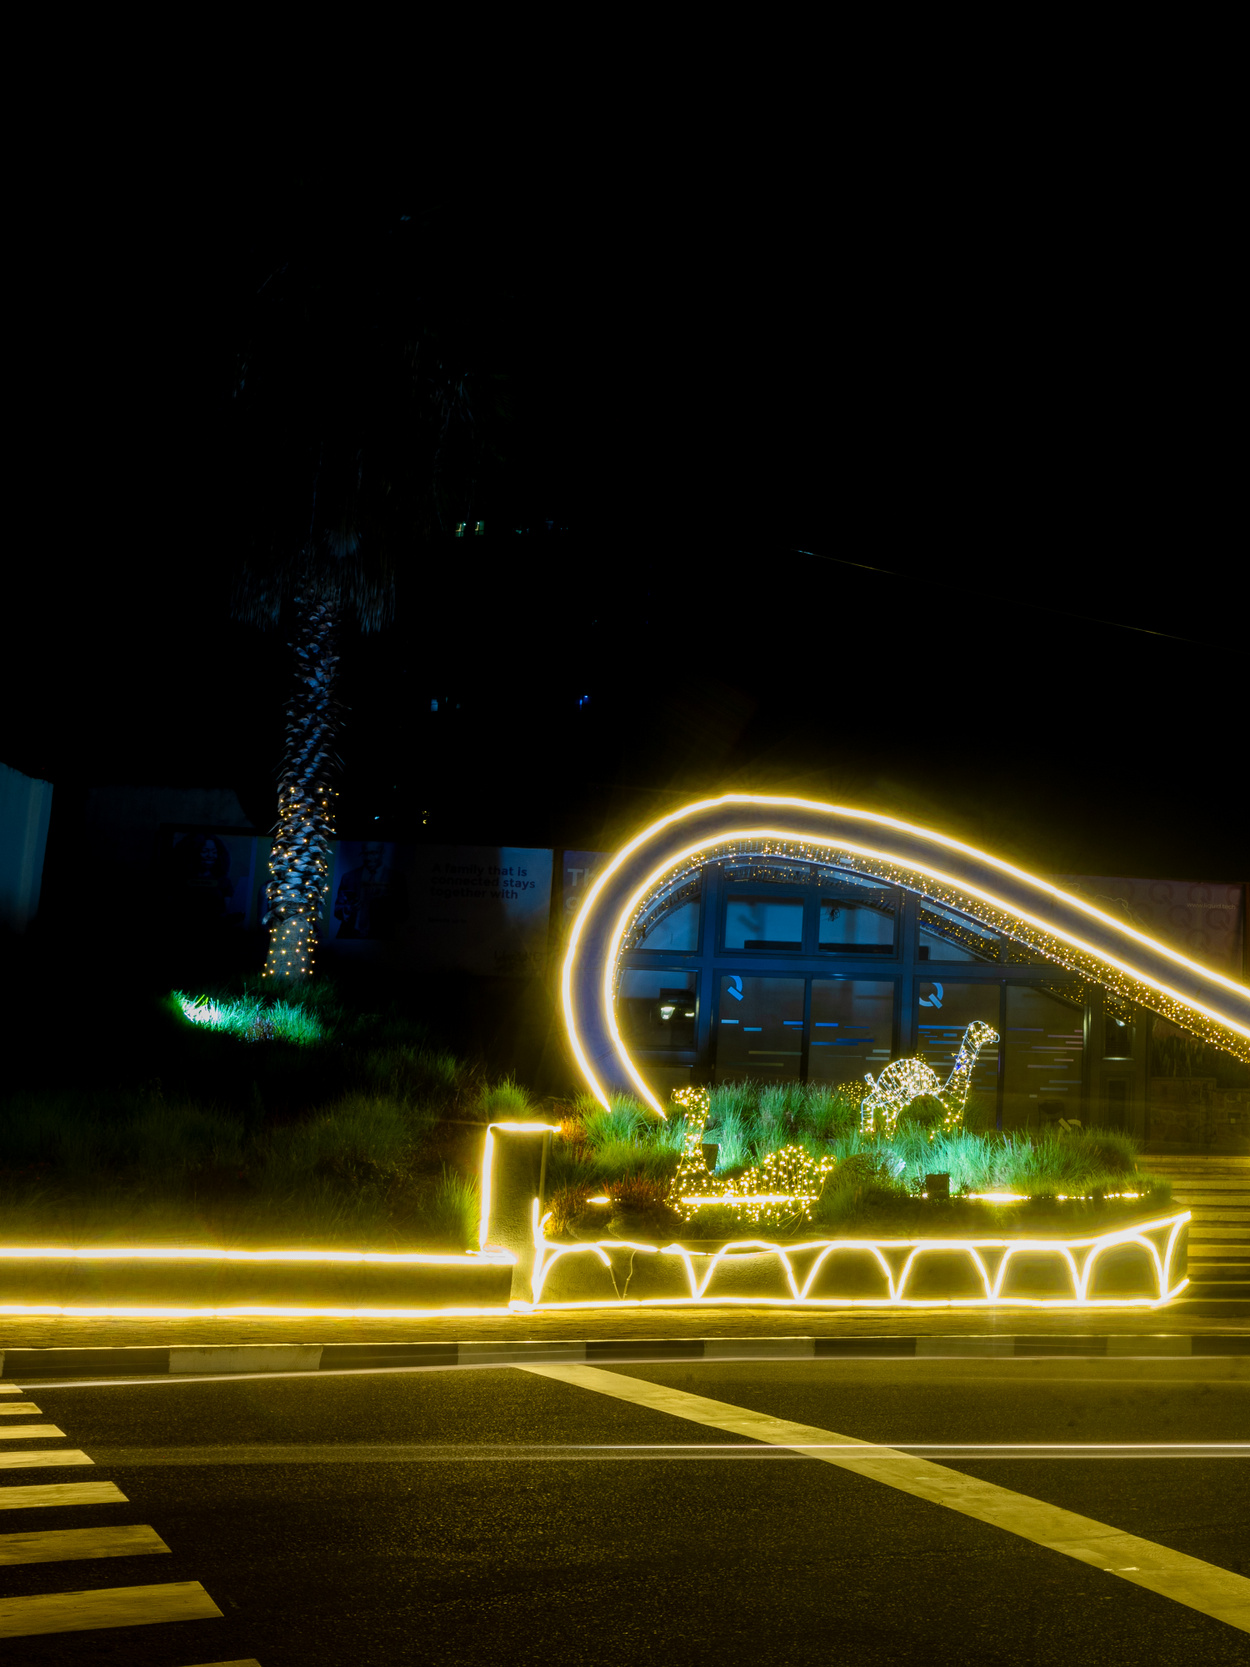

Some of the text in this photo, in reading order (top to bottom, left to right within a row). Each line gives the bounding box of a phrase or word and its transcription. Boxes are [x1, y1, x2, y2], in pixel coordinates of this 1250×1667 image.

[431, 863, 528, 877] A family that is
[430, 876, 536, 891] connected stays
[430, 886, 518, 900] together with
